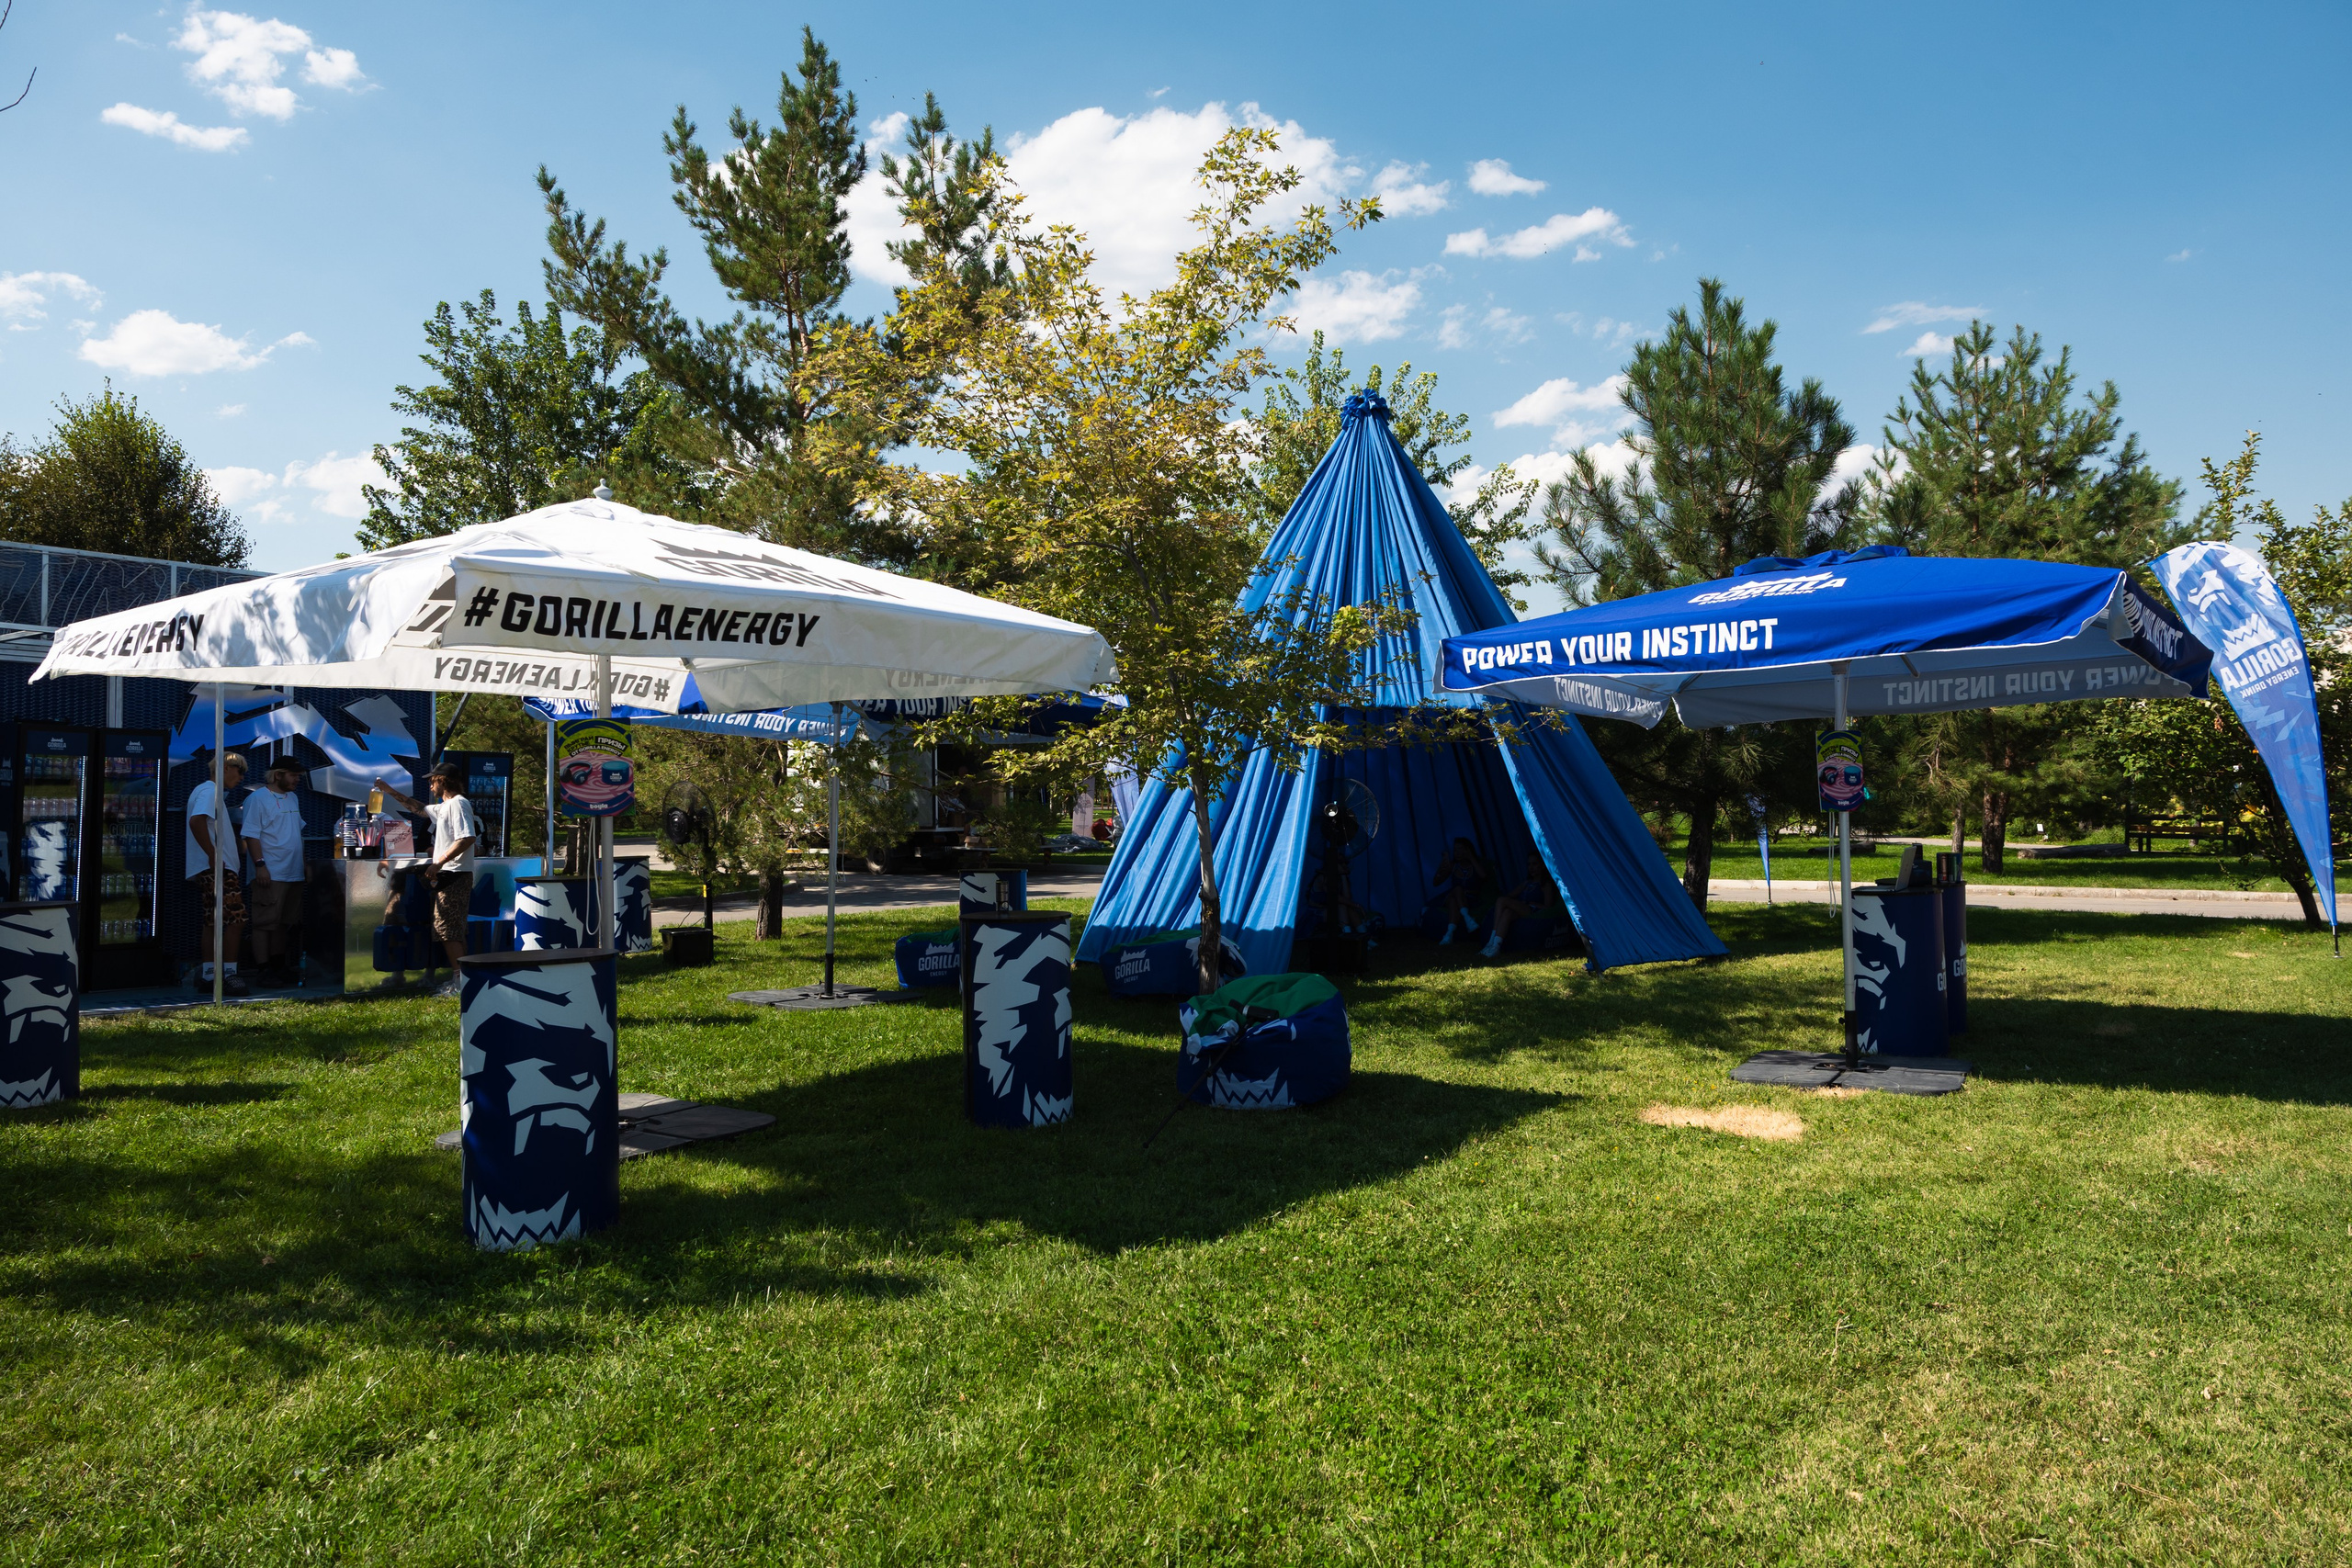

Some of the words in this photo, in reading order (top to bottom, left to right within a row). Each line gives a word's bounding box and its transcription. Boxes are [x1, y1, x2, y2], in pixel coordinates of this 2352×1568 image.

[654, 556, 905, 600] GORILLA
[1688, 578, 1847, 604] GORILLA
[464, 585, 820, 648] #GORILLAENERGY
[1462, 640, 1554, 673] POWER
[1561, 631, 1632, 666] YOUR
[1642, 618, 1779, 659] INSTINCT
[597, 737, 626, 750] ПРИЗЫ
[918, 953, 960, 972] GORILLA
[1114, 958, 1151, 980] GORILLA
